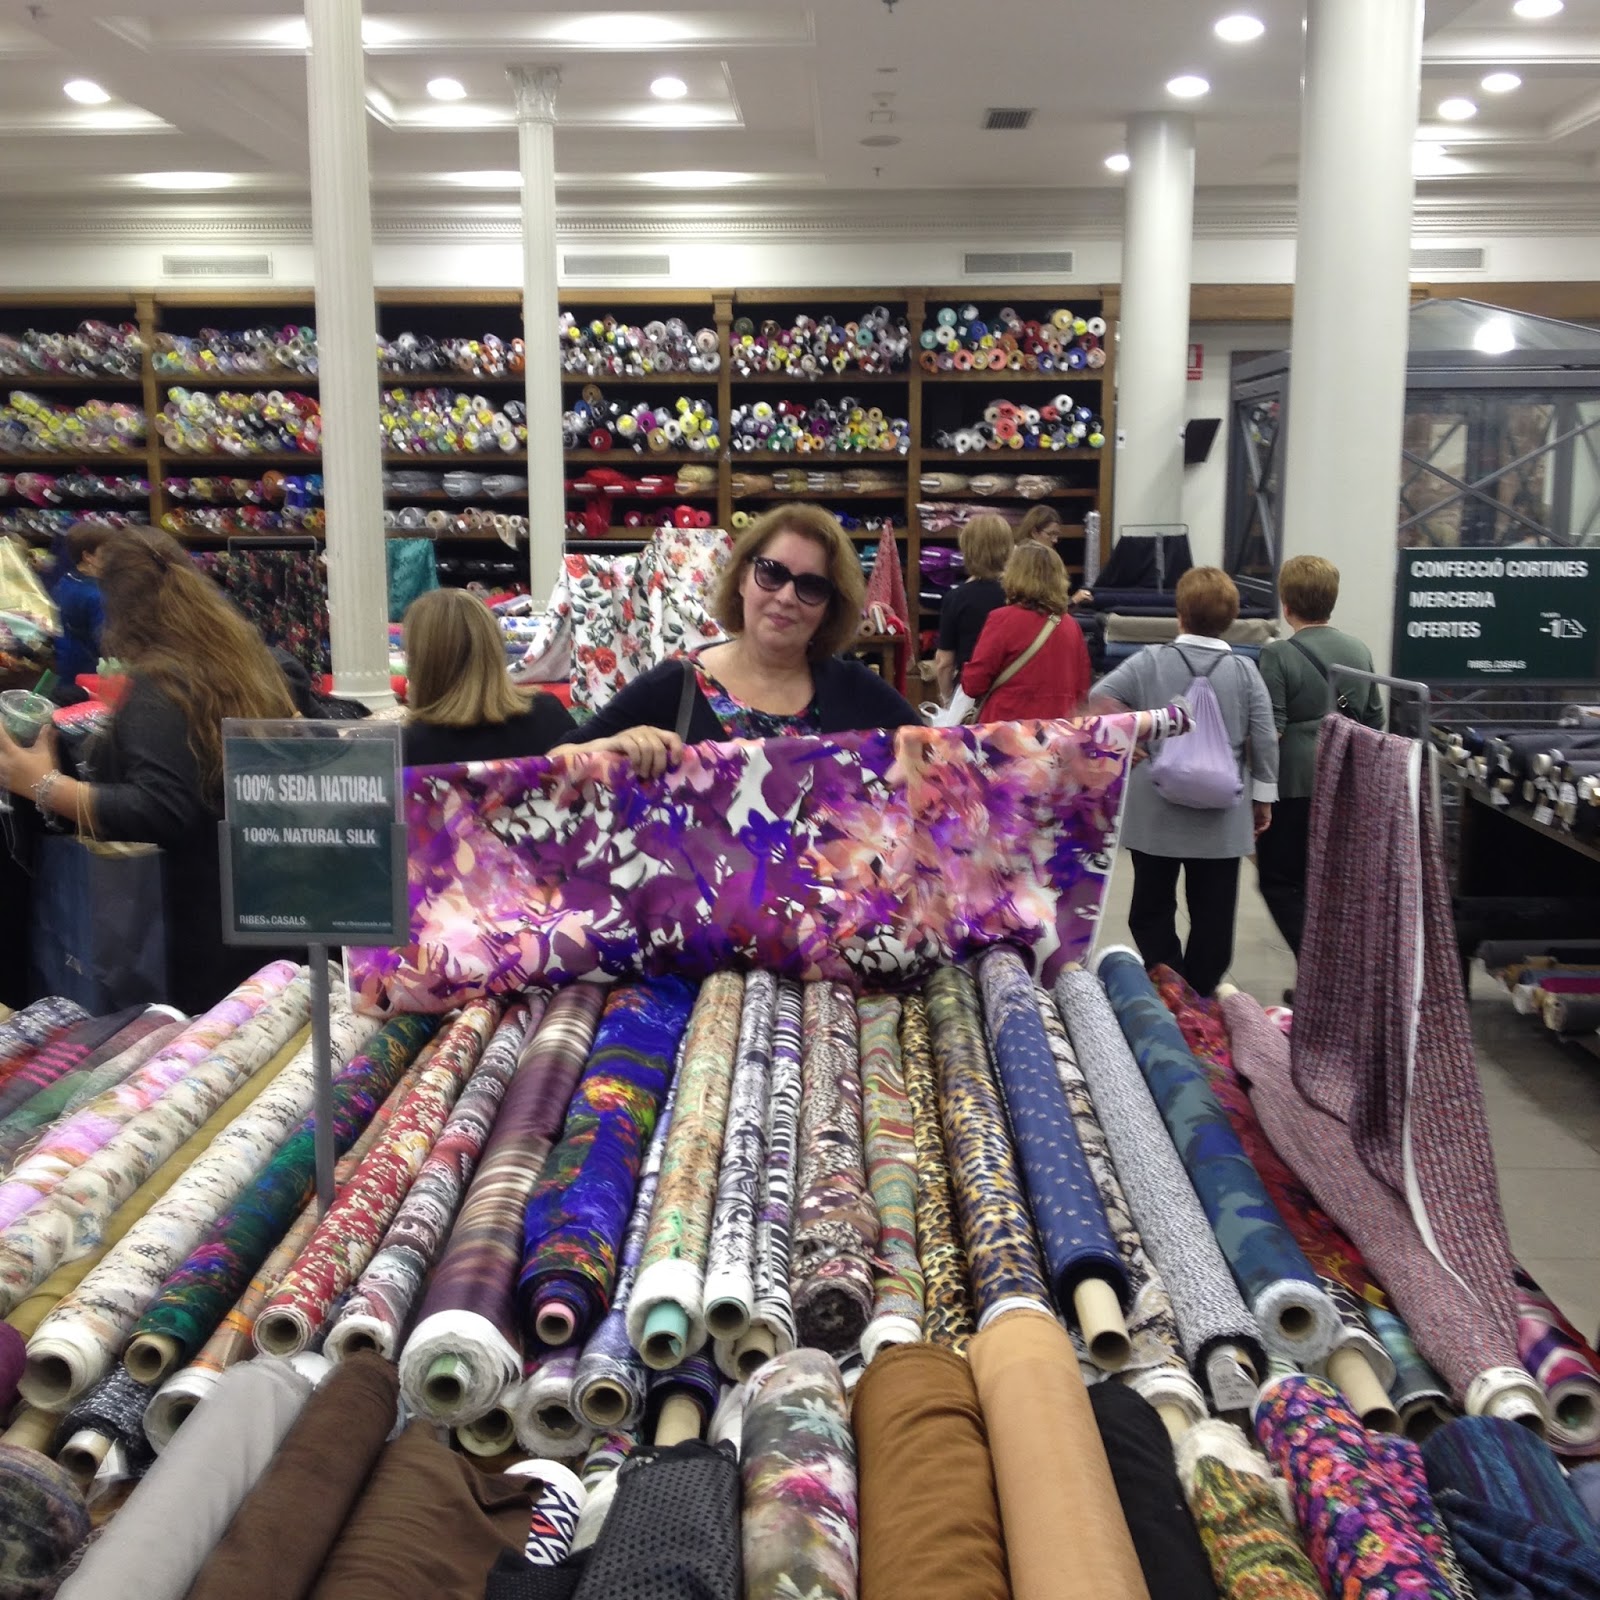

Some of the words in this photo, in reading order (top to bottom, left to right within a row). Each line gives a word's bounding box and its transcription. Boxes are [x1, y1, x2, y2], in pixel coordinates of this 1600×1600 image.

[1410, 557, 1504, 578] CONFECCIÓ
[1505, 560, 1589, 577] CORTINES
[1409, 591, 1496, 608] MERCERIA
[1407, 621, 1481, 638] OFERTES
[233, 774, 275, 801] 100%
[278, 774, 317, 802] SEDA
[320, 775, 387, 803] NATURAL
[242, 827, 279, 843] 100%
[283, 828, 342, 844] NATURAL
[346, 828, 376, 845] SILK
